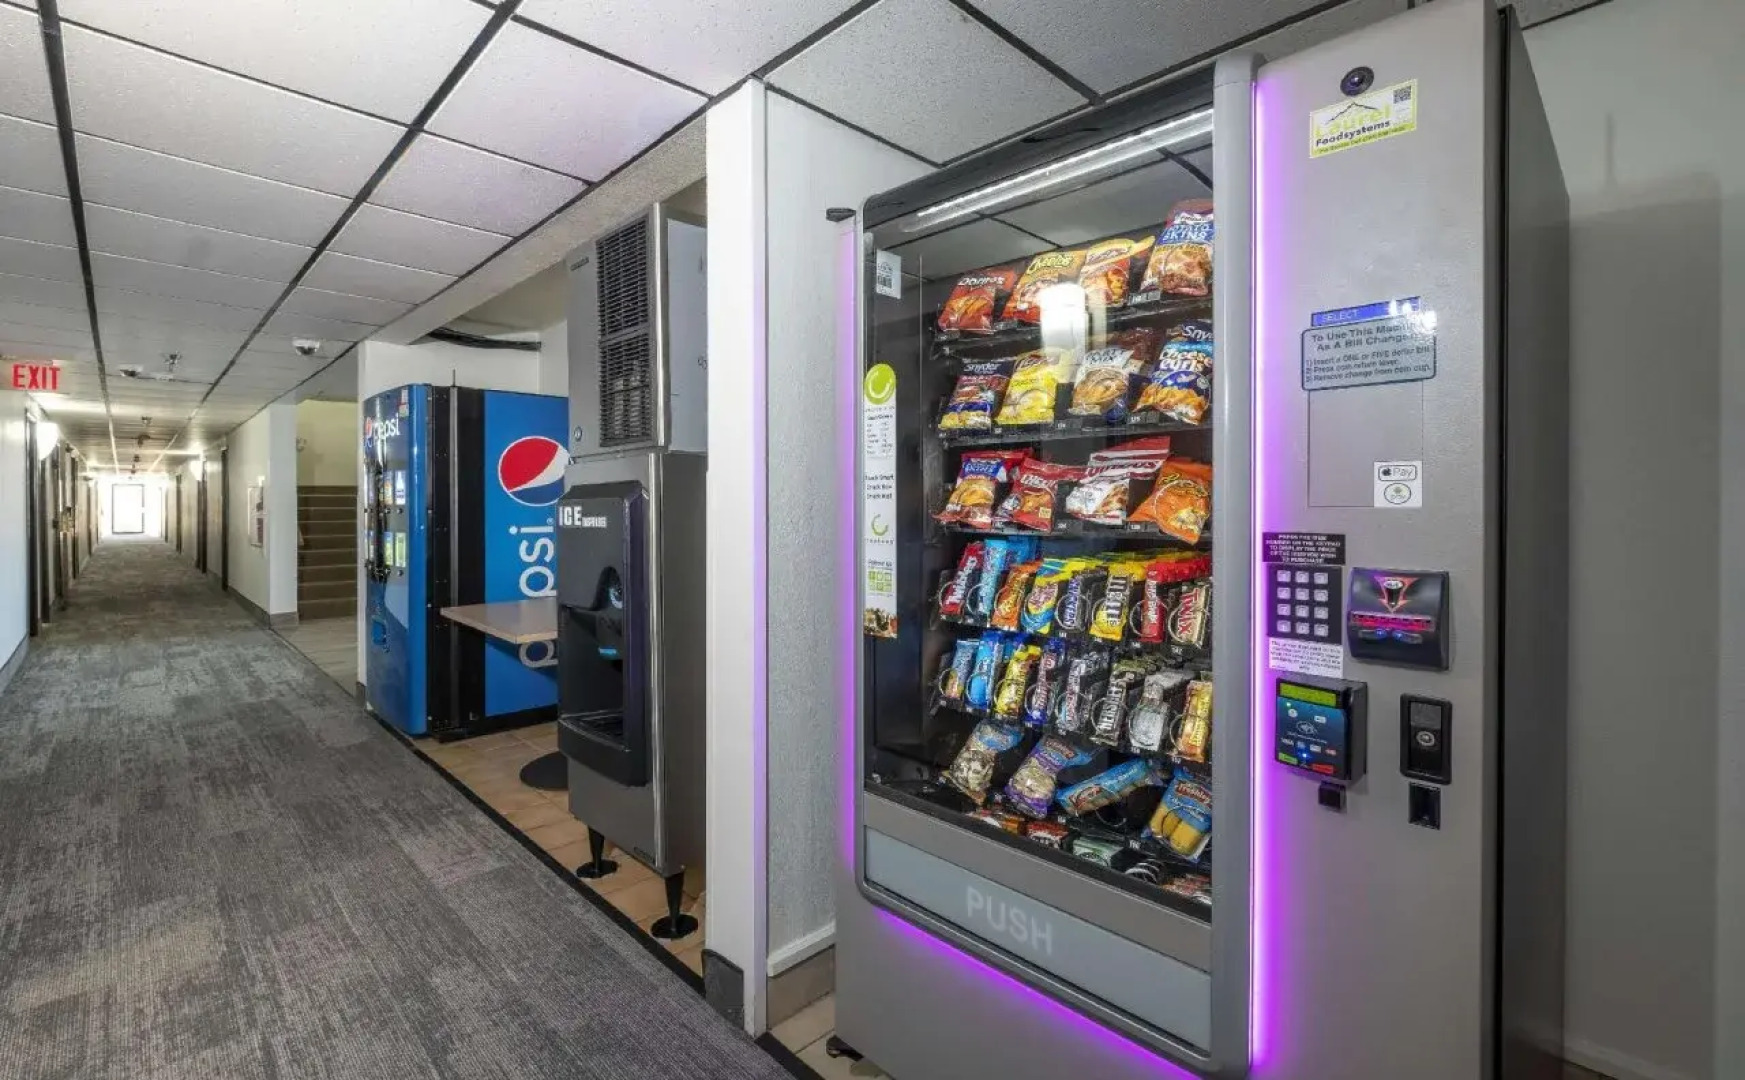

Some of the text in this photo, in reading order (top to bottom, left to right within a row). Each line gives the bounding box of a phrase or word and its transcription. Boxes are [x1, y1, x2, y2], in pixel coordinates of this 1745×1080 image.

[1312, 334, 1324, 342] To
[1327, 331, 1347, 341] Use
[1349, 327, 1373, 338] This
[1334, 341, 1341, 349] A
[1345, 337, 1363, 348] Bill
[1372, 350, 1390, 359] FIVE
[13, 364, 61, 391] EXIT
[559, 506, 582, 526] ICE
[509, 525, 557, 668] ppsi
[966, 885, 1053, 957] PUSH
